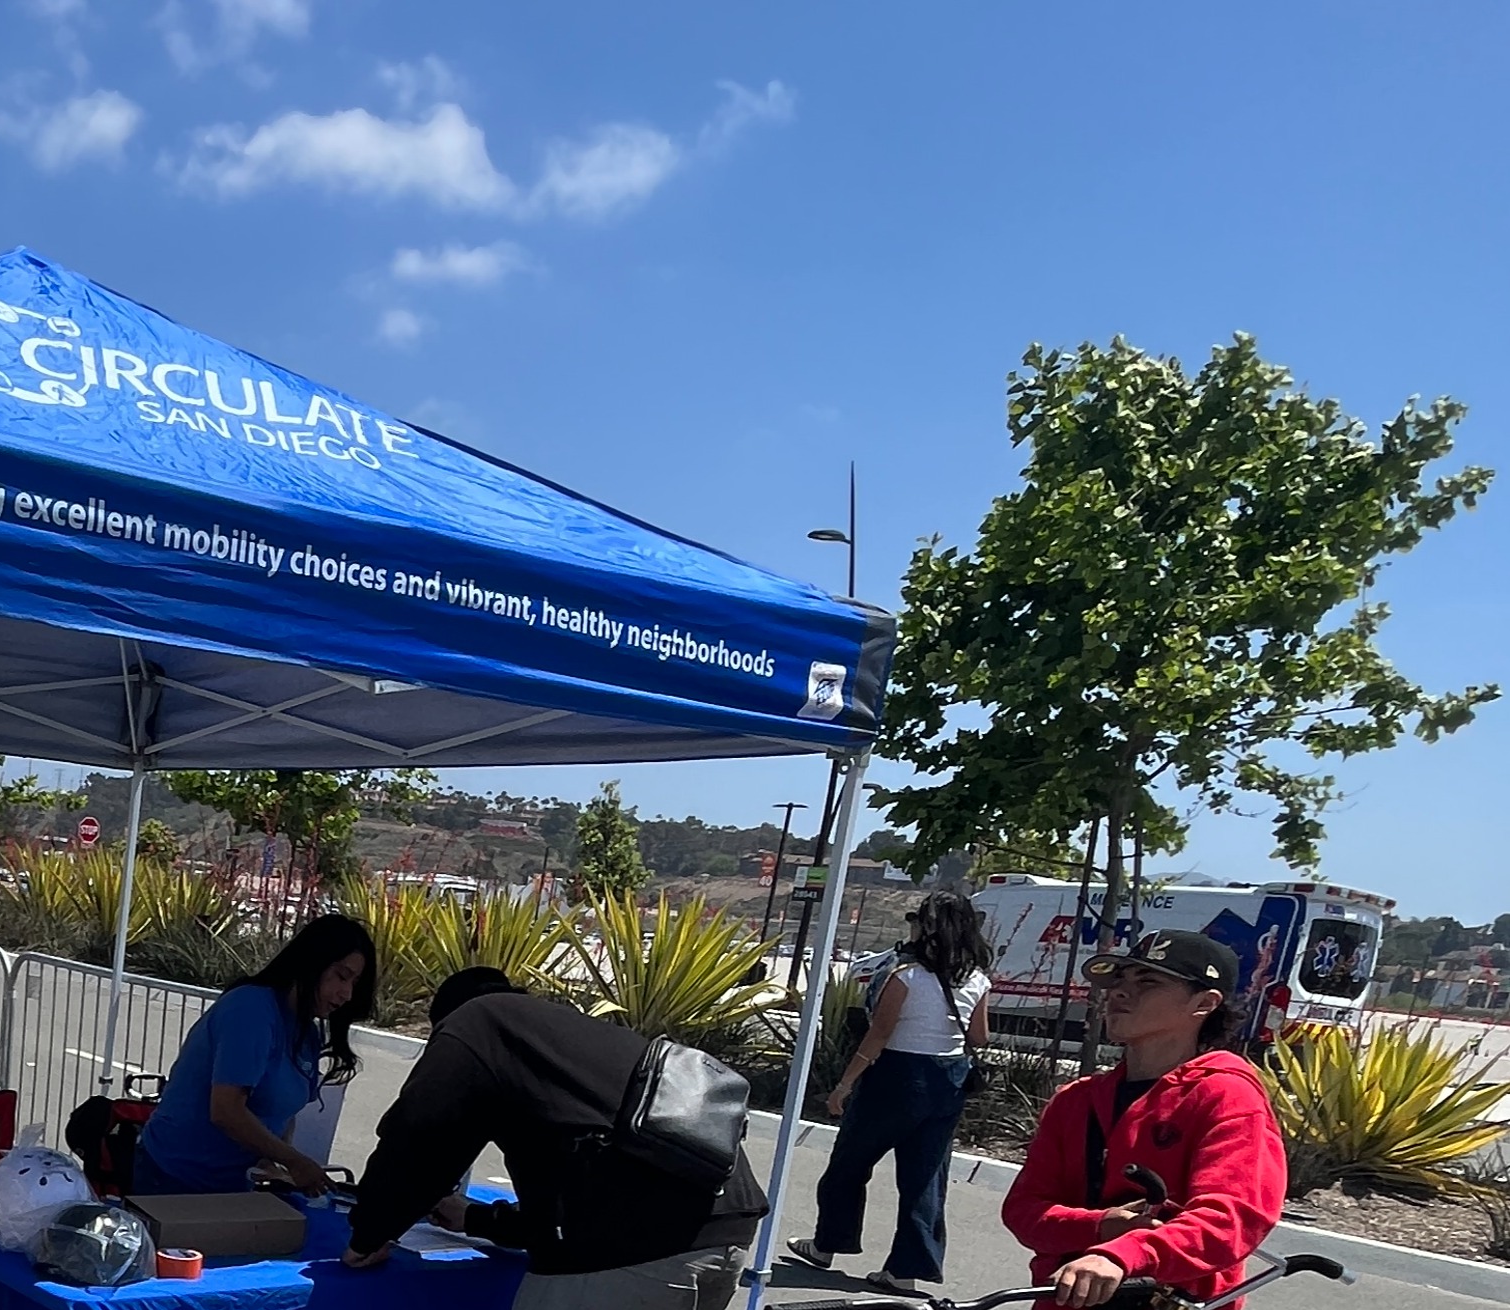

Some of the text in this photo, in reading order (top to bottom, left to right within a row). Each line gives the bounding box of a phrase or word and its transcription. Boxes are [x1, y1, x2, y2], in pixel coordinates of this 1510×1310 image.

[19, 337, 421, 459] CIRCULATE
[136, 400, 383, 471] SAN DIEGO
[14, 490, 157, 546] excellent
[163, 522, 285, 578] mobility
[289, 544, 388, 592] choices
[392, 571, 441, 602] and
[446, 578, 537, 627] vibrant,
[541, 596, 624, 649] healthy
[627, 624, 776, 679] neighborhoods
[80, 824, 99, 836] STOP
